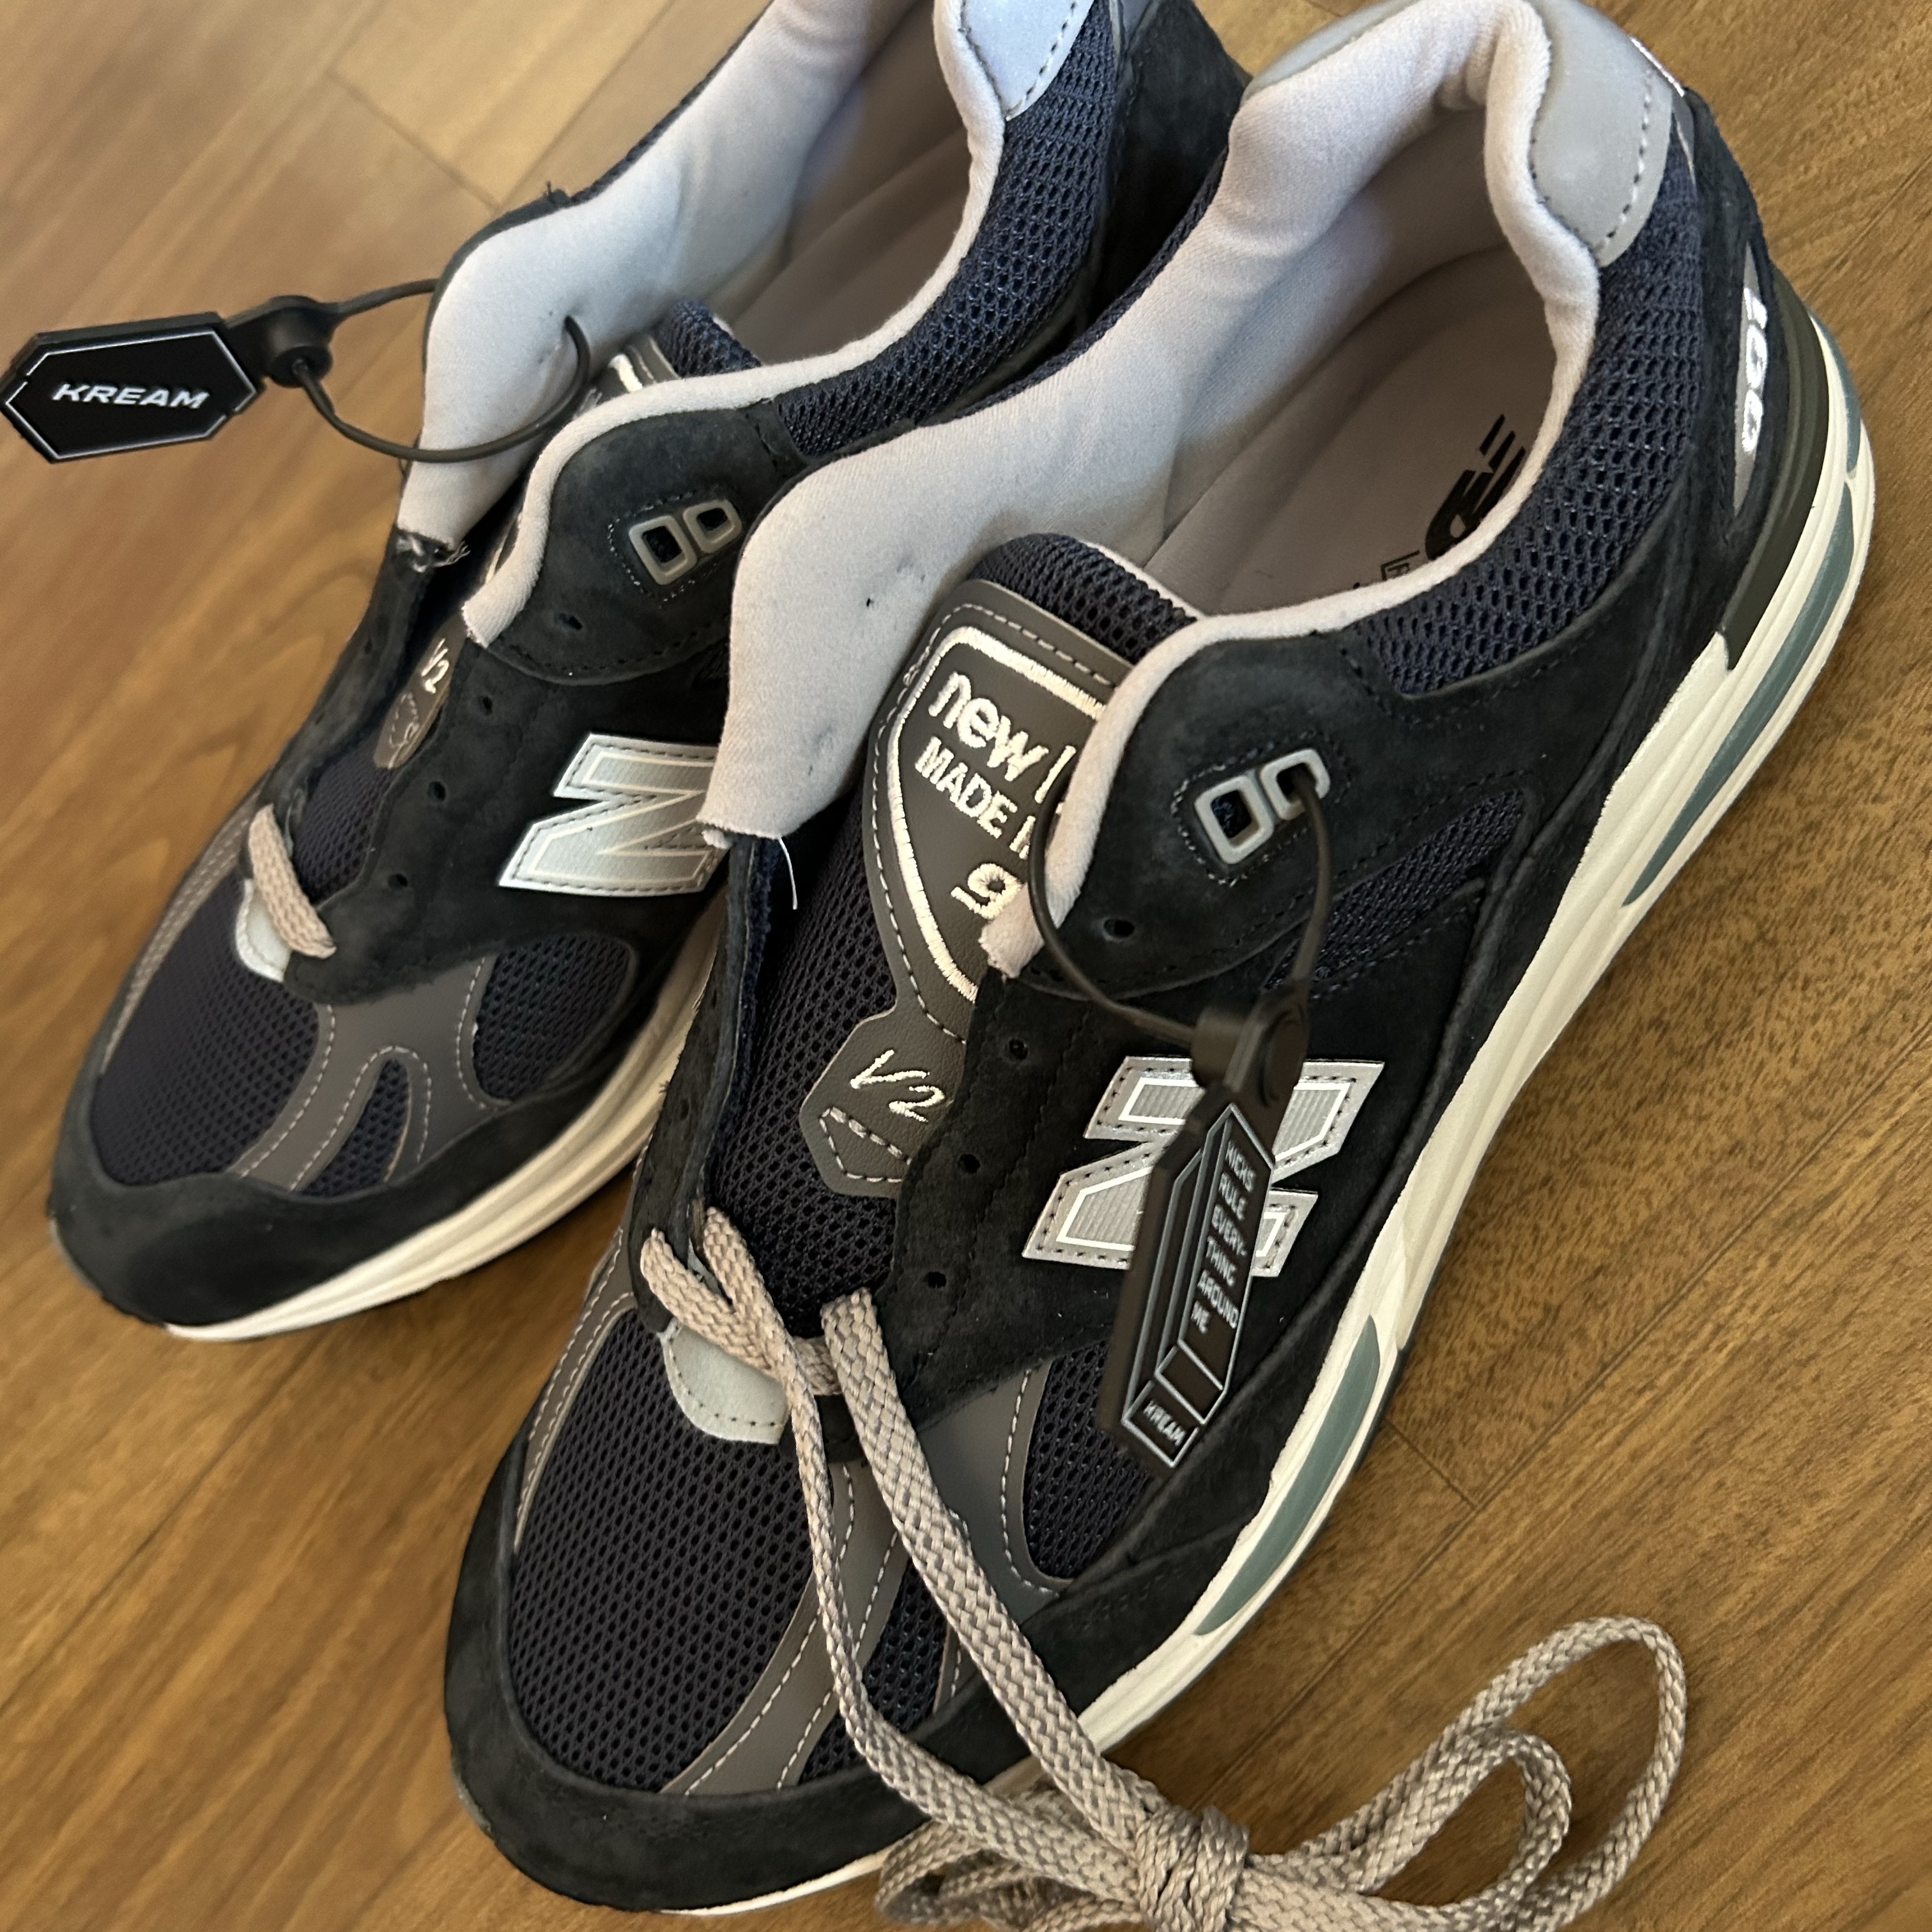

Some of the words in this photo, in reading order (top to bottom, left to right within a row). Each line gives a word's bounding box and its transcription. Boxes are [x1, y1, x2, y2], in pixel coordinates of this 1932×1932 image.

[52, 383, 210, 410] KREAM
[928, 671, 1049, 782] new
[914, 736, 1018, 839] MADE
[1225, 1139, 1257, 1193] KICKS
[1218, 1172, 1248, 1221] RULE
[1211, 1204, 1248, 1256] EVERY-
[1206, 1236, 1237, 1287] THING
[1191, 1300, 1211, 1334] ME
[1197, 1269, 1239, 1329] AROUND
[1142, 1399, 1186, 1446] KREAM
